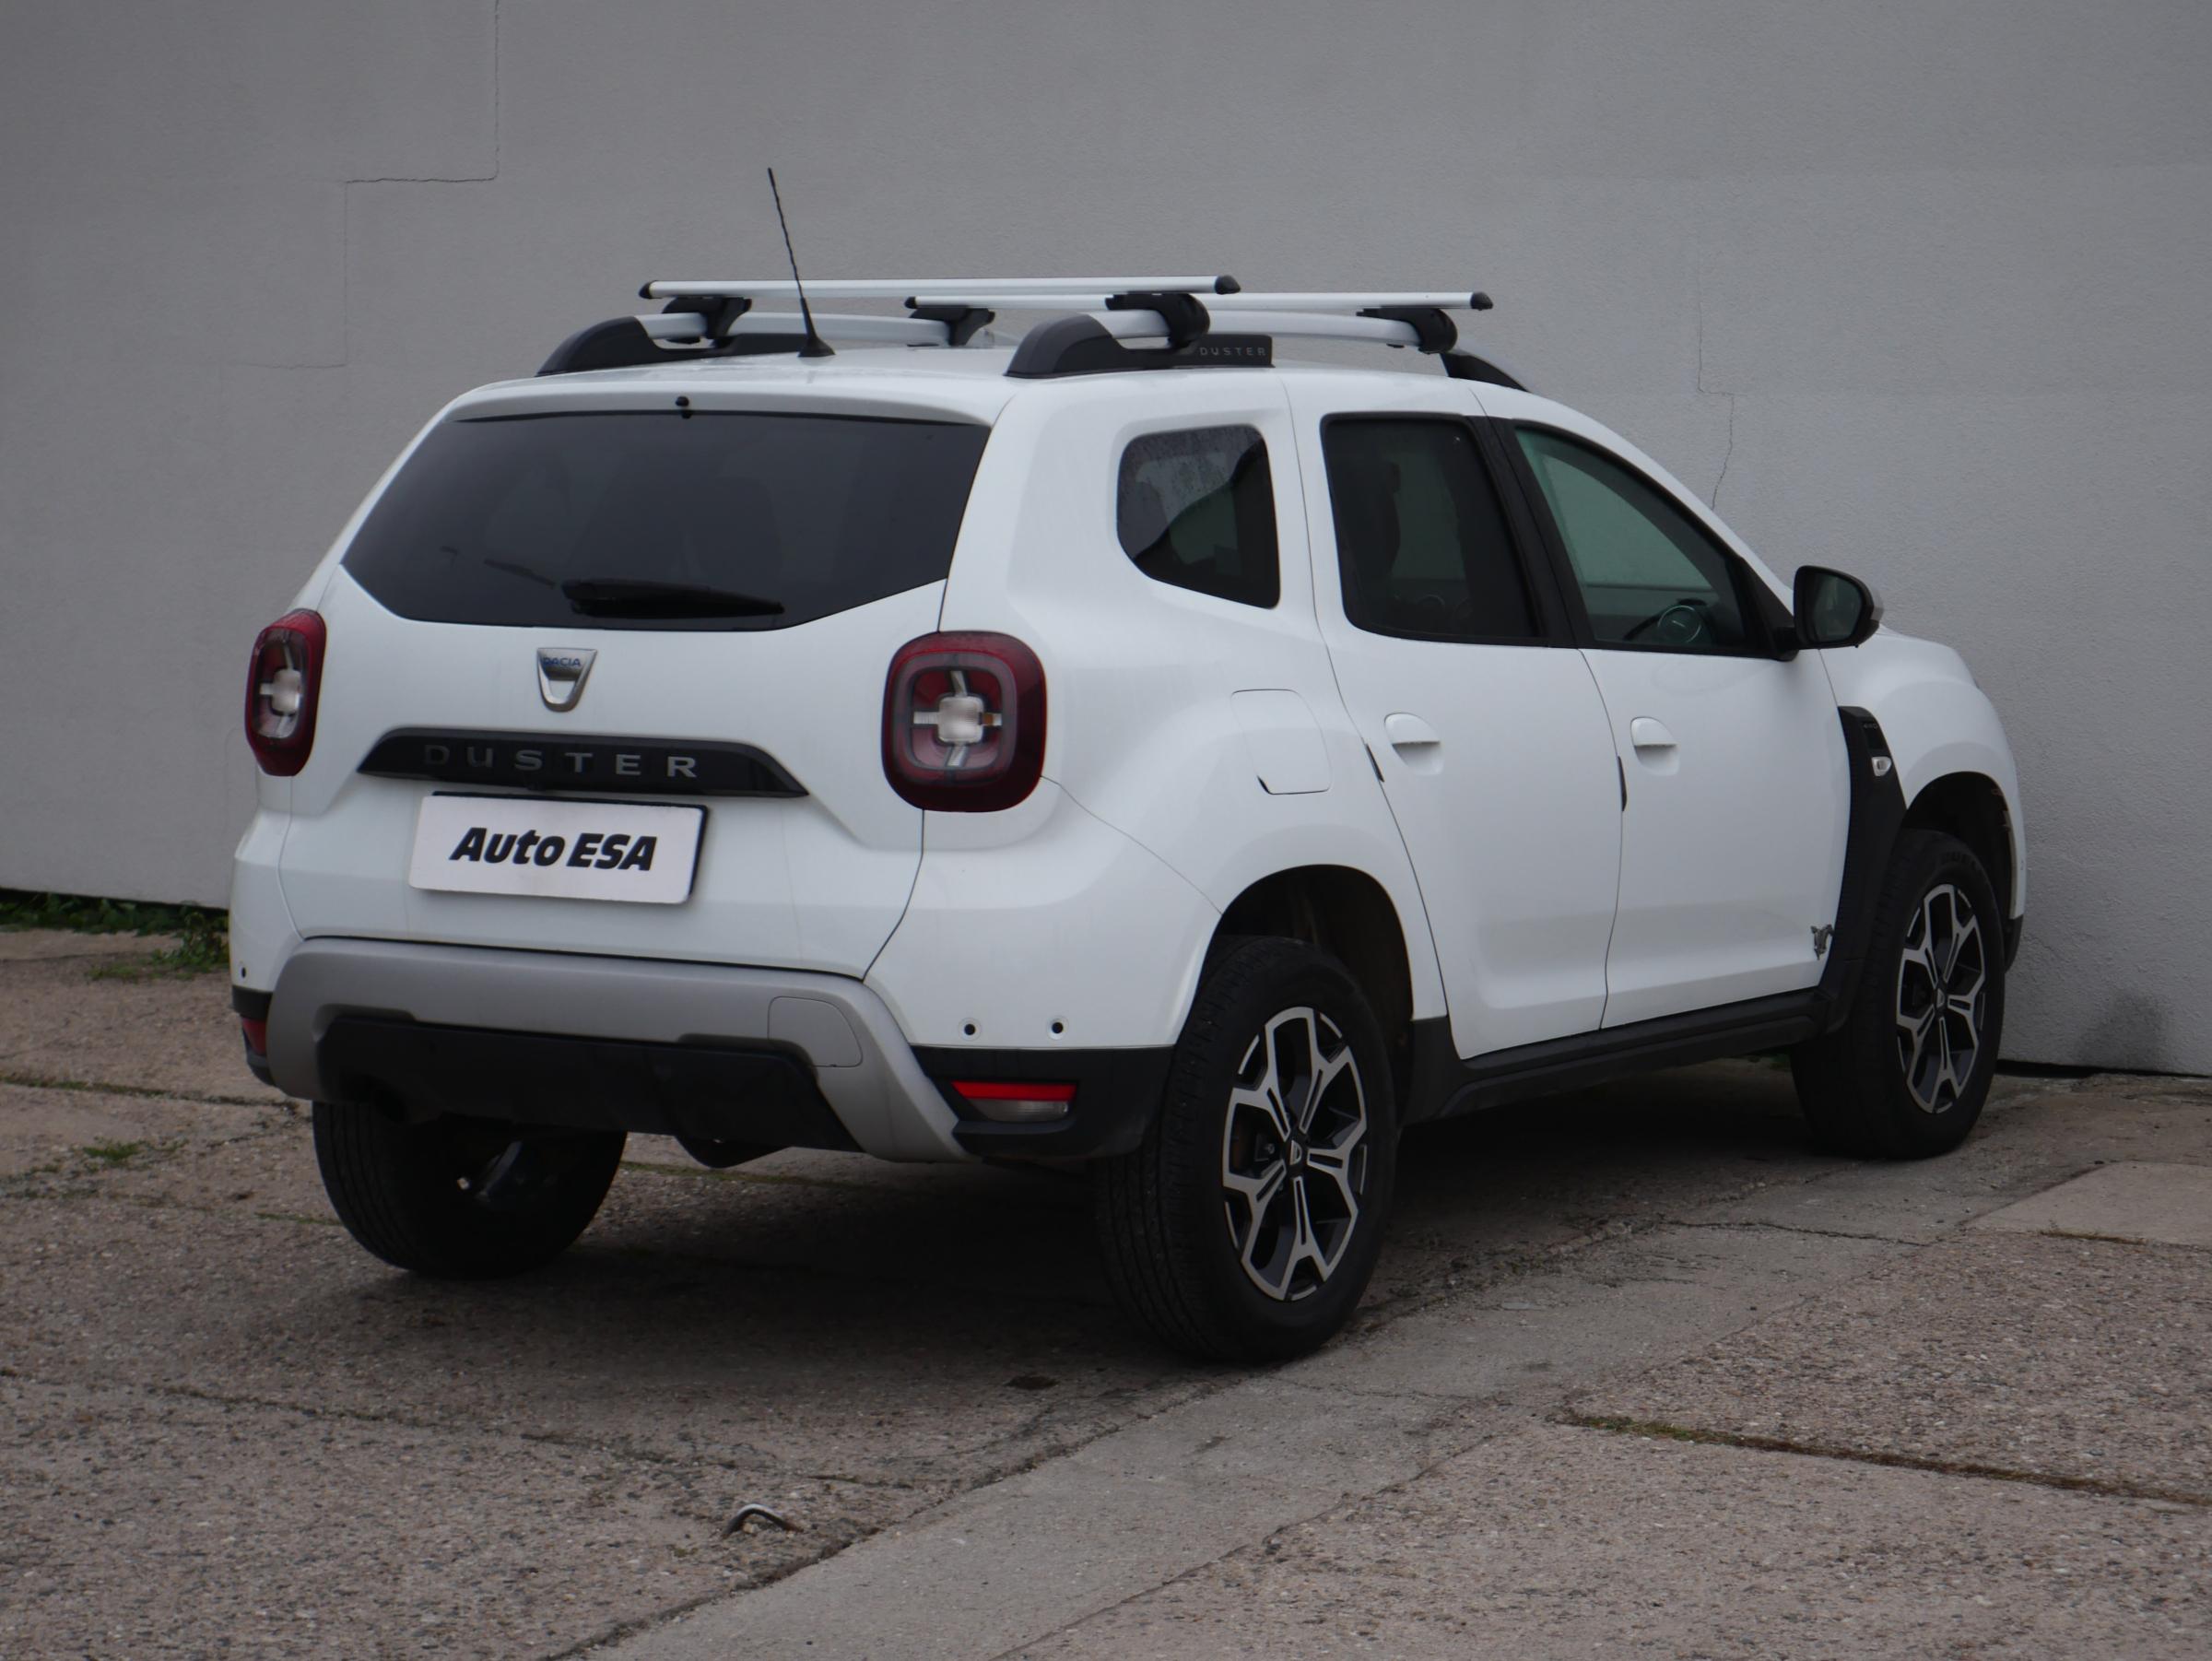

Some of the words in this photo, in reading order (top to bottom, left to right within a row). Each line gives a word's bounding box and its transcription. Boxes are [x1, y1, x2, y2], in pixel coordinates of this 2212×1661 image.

[1199, 347, 1266, 356] DUSTER
[543, 656, 581, 666] DACIA
[423, 744, 698, 778] DUSTER
[448, 827, 566, 866] Auto
[566, 832, 657, 871] ESA
